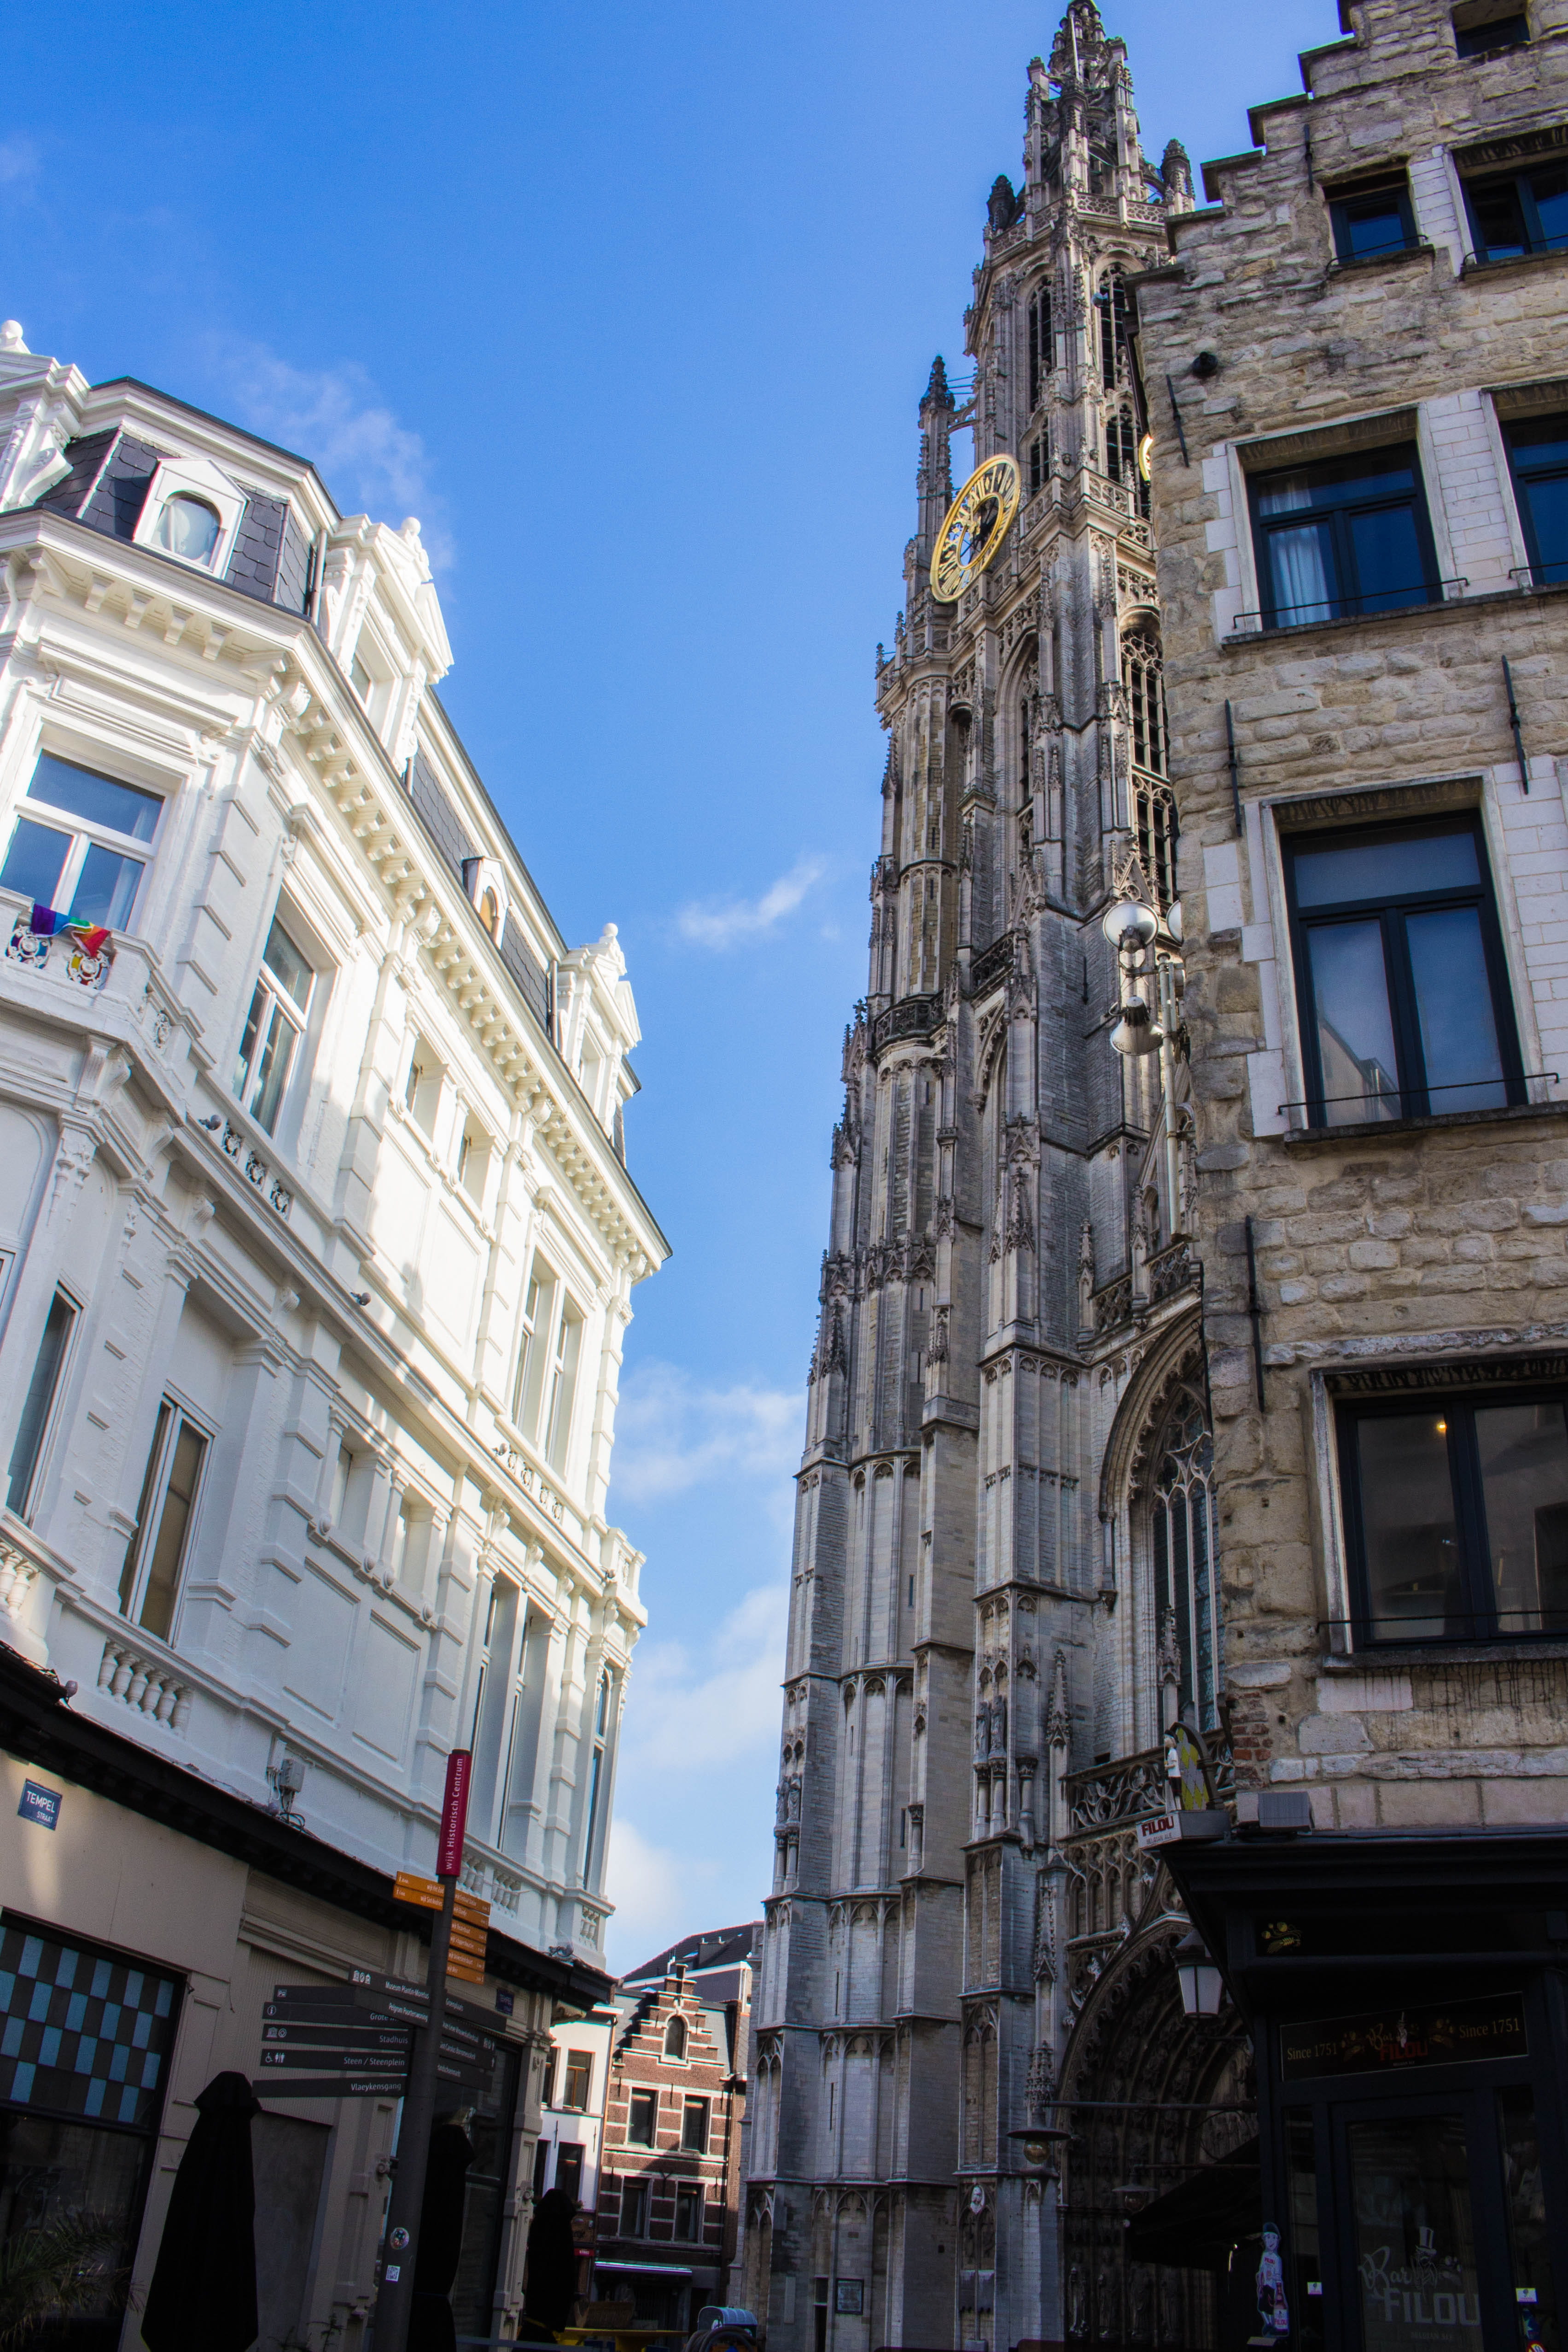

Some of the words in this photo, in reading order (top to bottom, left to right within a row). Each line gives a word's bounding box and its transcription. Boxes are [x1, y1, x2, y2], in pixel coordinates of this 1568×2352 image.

[452, 1758, 463, 1798] Centrum
[27, 1790, 55, 1813] TEMPEL
[37, 1811, 53, 1822] STRAAT
[447, 1800, 459, 1848] Historisch
[1141, 1815, 1174, 1837] FILOU
[446, 1850, 455, 1870] wijk
[385, 1981, 401, 1992] Museum
[401, 1985, 430, 2000] Plantin-Moretus
[370, 2012, 388, 2021] Grote
[389, 2002, 403, 2013] Pelgrom
[403, 2007, 428, 2023] Poorterswoning
[1458, 2025, 1489, 2038] Since
[1492, 2017, 1521, 2034] 1751
[379, 2035, 408, 2044] Stadhuis
[1287, 2047, 1312, 2060] Since
[1314, 2041, 1338, 2058] 1751
[1378, 2040, 1429, 2063] FILOU
[369, 2057, 405, 2066] Steenplein
[351, 2082, 402, 2092] Vlaeykensgang
[1357, 2245, 1412, 2300] Bar
[1383, 2288, 1481, 2326] FILOU
